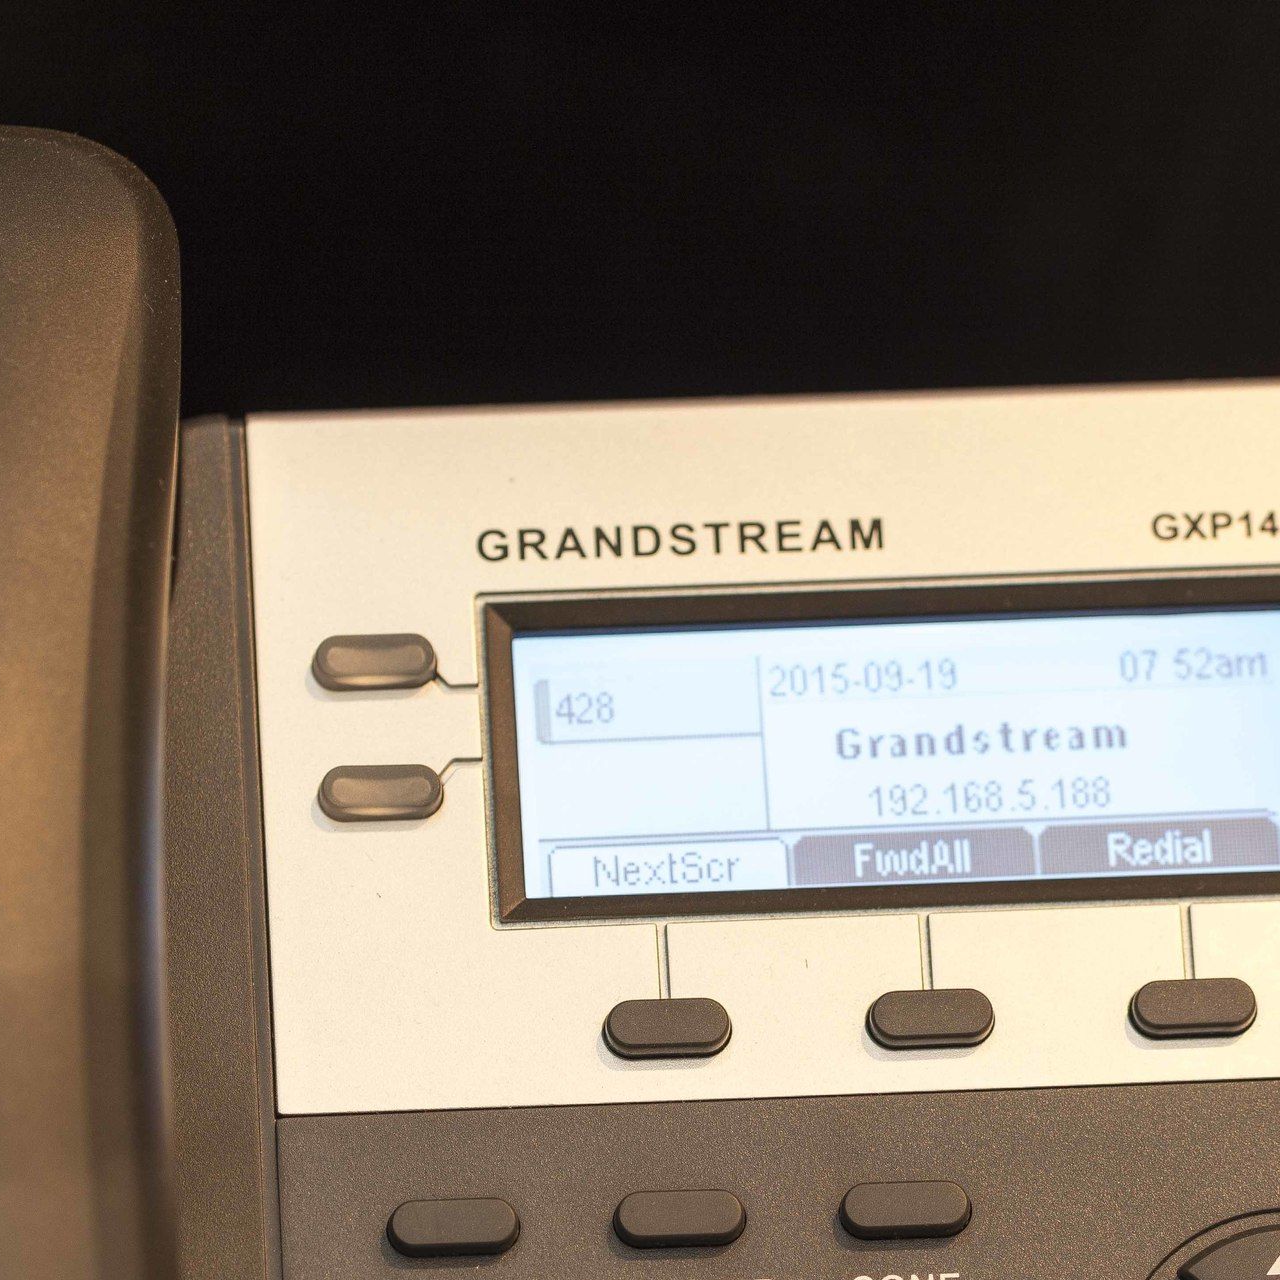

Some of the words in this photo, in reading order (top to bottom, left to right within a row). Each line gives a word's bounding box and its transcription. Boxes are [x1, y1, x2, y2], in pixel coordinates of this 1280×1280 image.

[476, 517, 885, 562] GRANDSTREAM
[768, 657, 958, 698] 2015-09-19
[555, 692, 616, 726] 428
[835, 722, 1129, 760] Grandstream
[868, 776, 1112, 817] 192.168.5.188
[853, 839, 972, 878] FwdAll
[1107, 829, 1213, 868] Redial
[593, 852, 741, 888] NextScr
